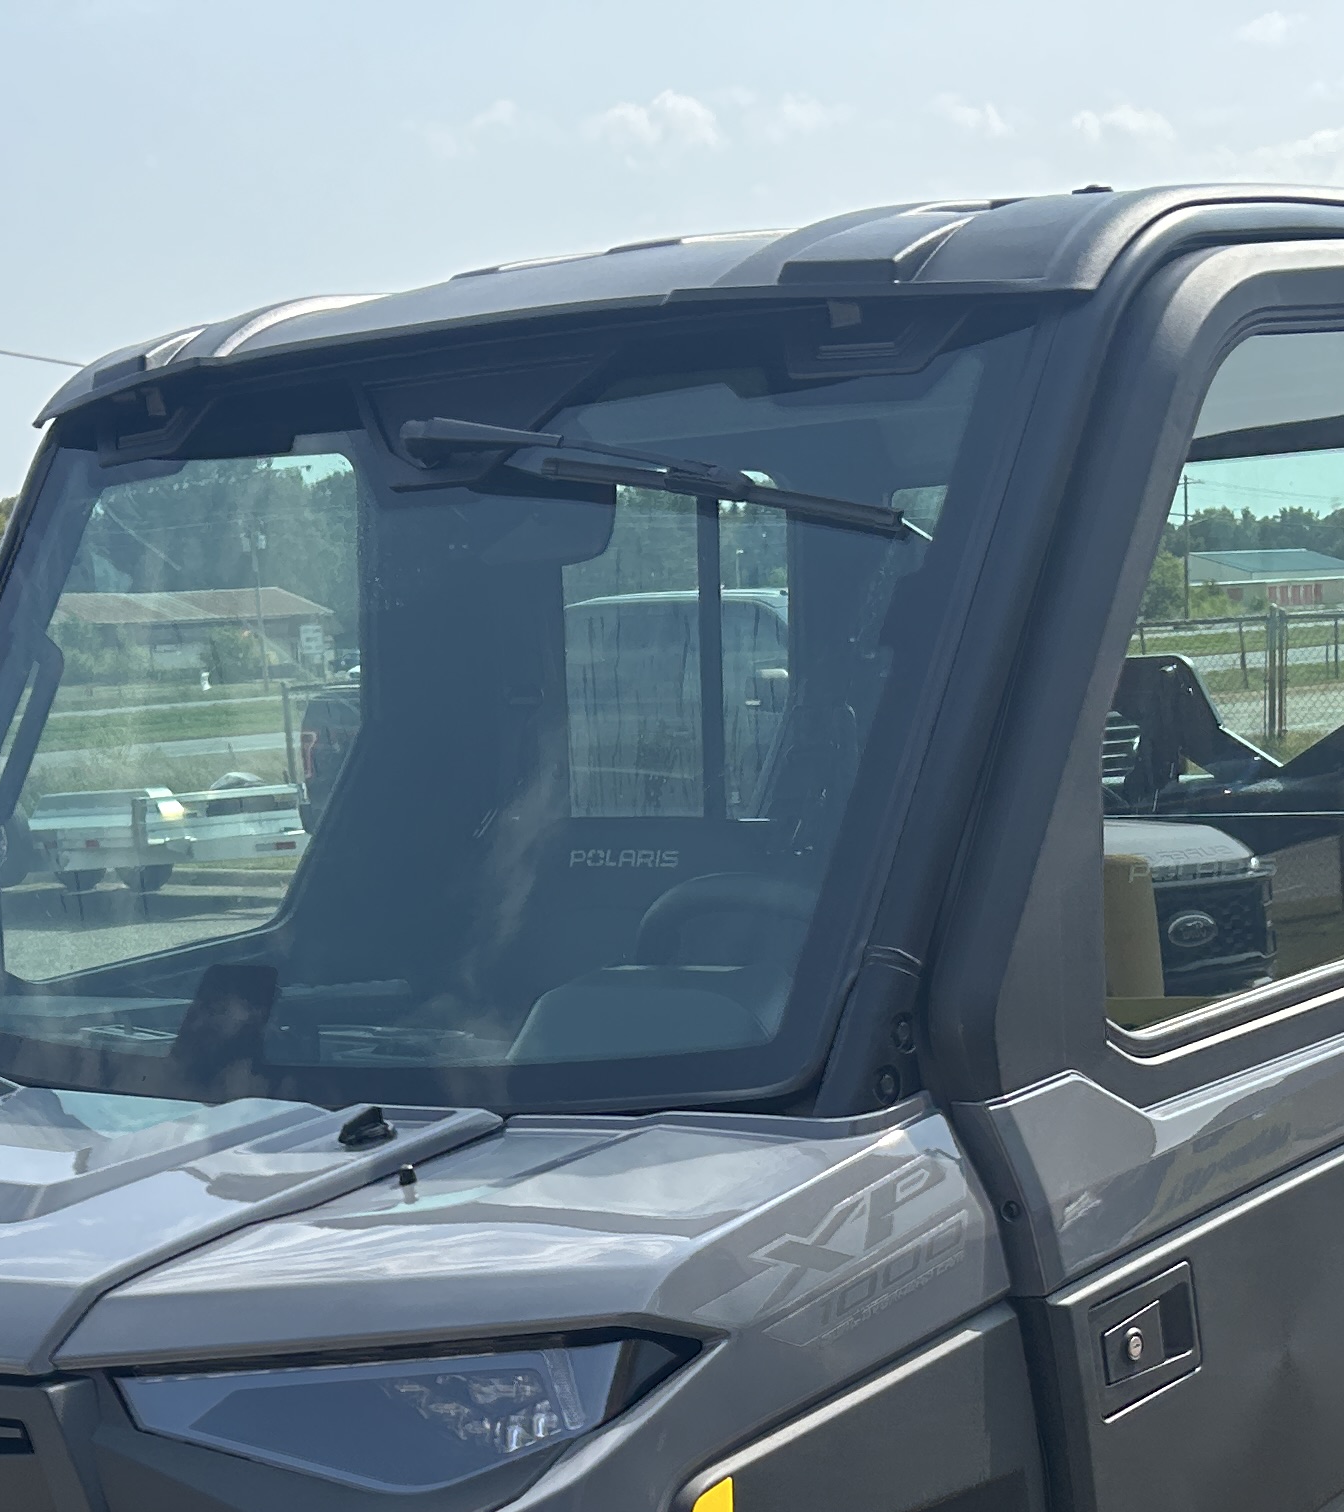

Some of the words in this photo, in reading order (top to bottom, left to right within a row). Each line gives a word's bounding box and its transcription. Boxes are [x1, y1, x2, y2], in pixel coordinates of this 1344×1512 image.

[568, 848, 680, 869] POLARIS
[752, 1156, 948, 1320] XP
[820, 1216, 965, 1326] 1000
